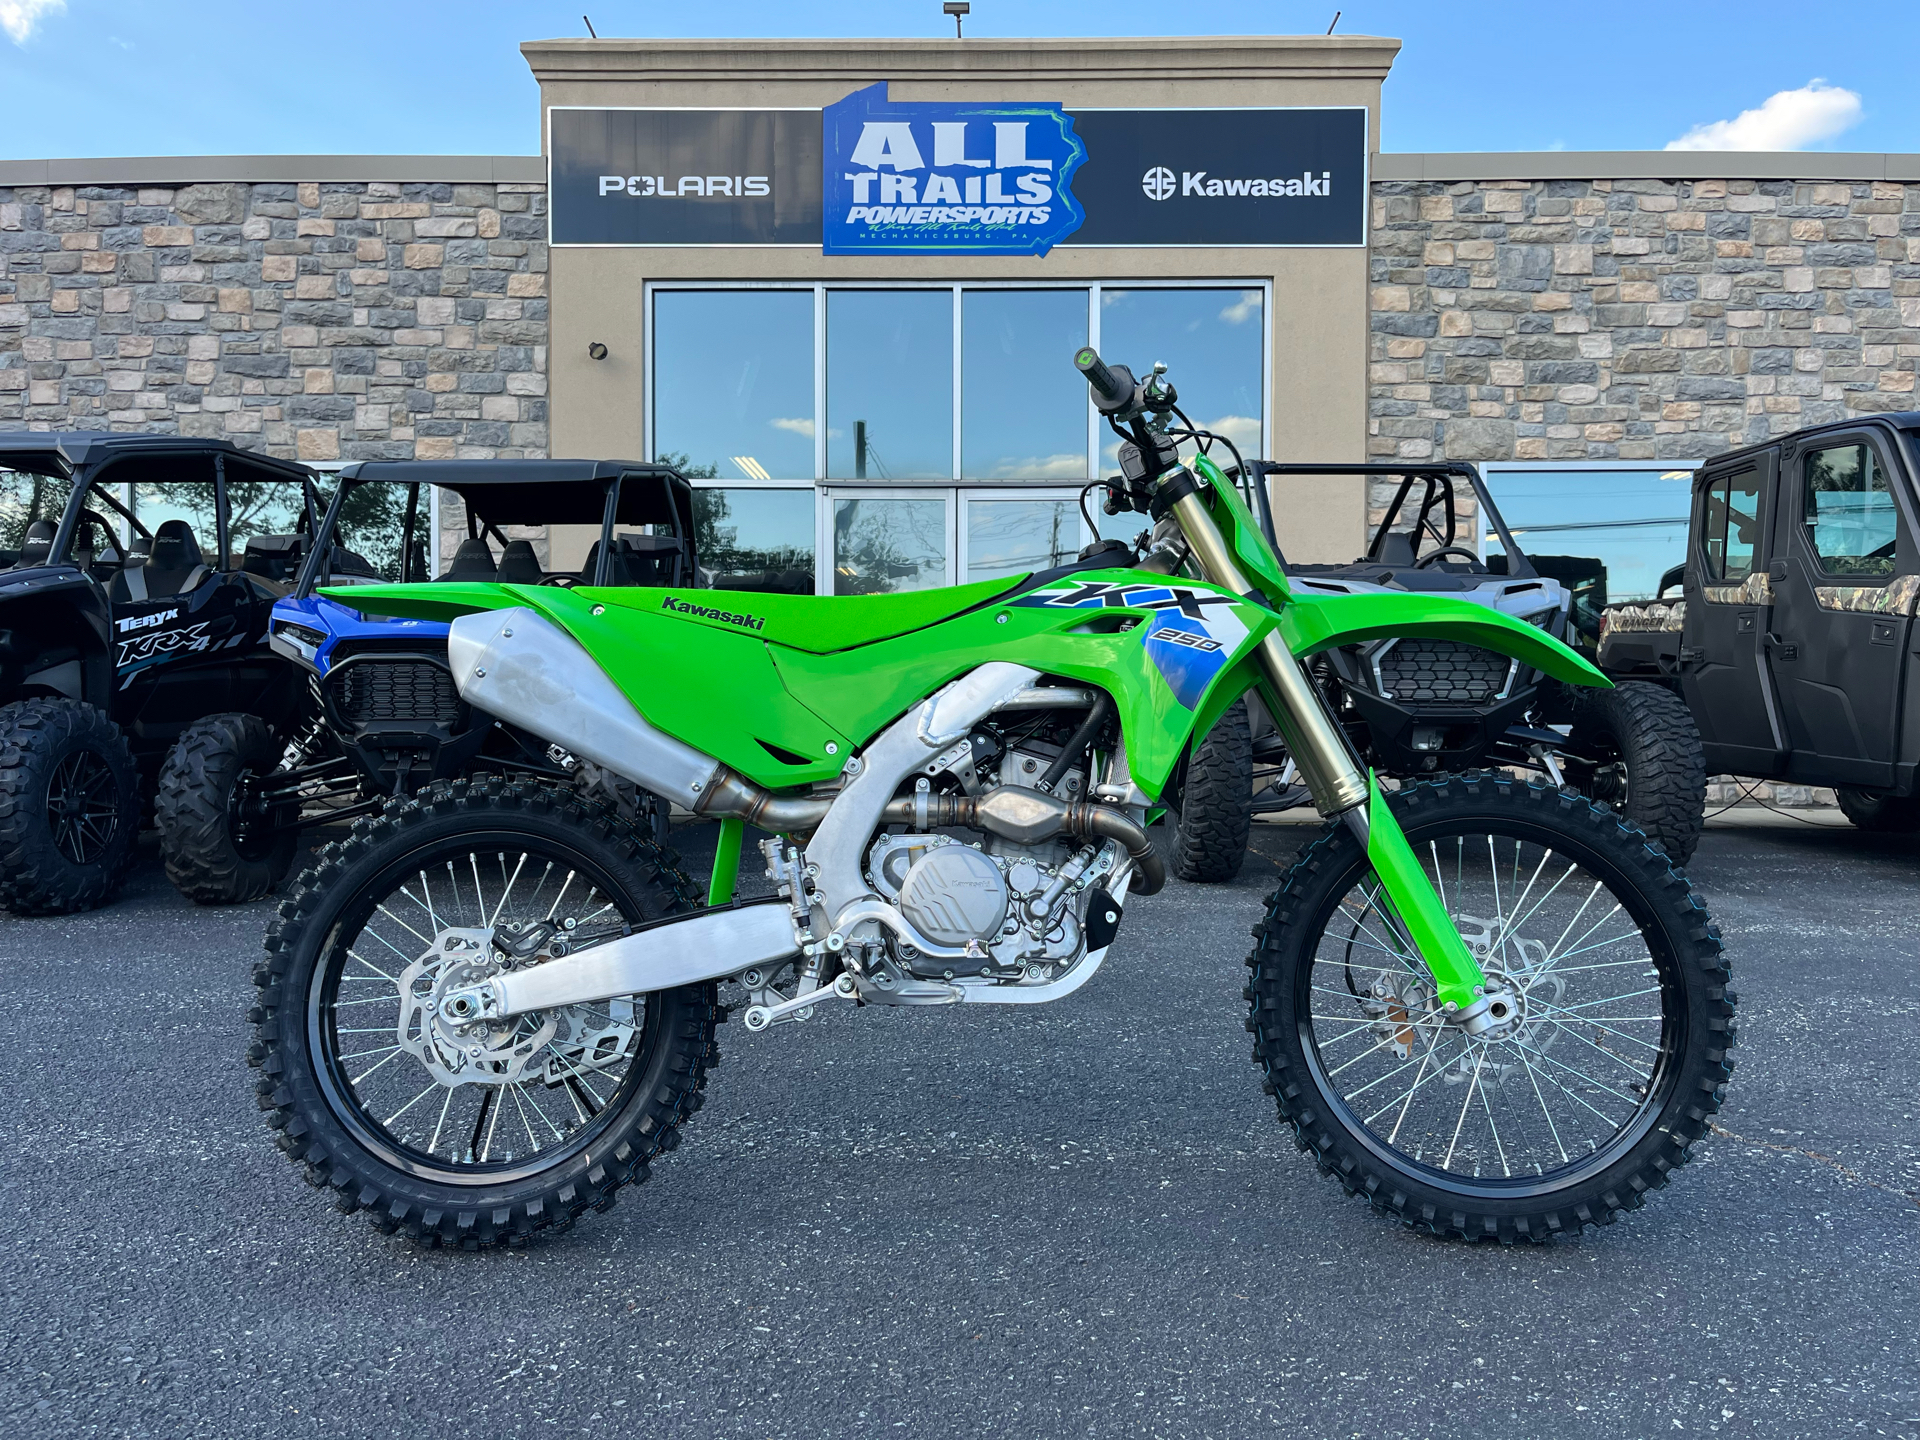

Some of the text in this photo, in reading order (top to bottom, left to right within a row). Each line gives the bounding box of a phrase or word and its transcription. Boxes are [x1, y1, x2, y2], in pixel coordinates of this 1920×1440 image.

[850, 122, 1052, 172] ALL
[599, 176, 770, 196] POLARIS
[845, 172, 1053, 205] TRAILS
[1182, 171, 1330, 197] Kawasaki
[845, 206, 1052, 225] POWERSPORTS
[662, 596, 765, 630] Kawasaki
[1044, 580, 1244, 622] KX
[115, 608, 179, 633] TERYX
[1621, 618, 1664, 627] RANGER
[1149, 627, 1224, 653] 250
